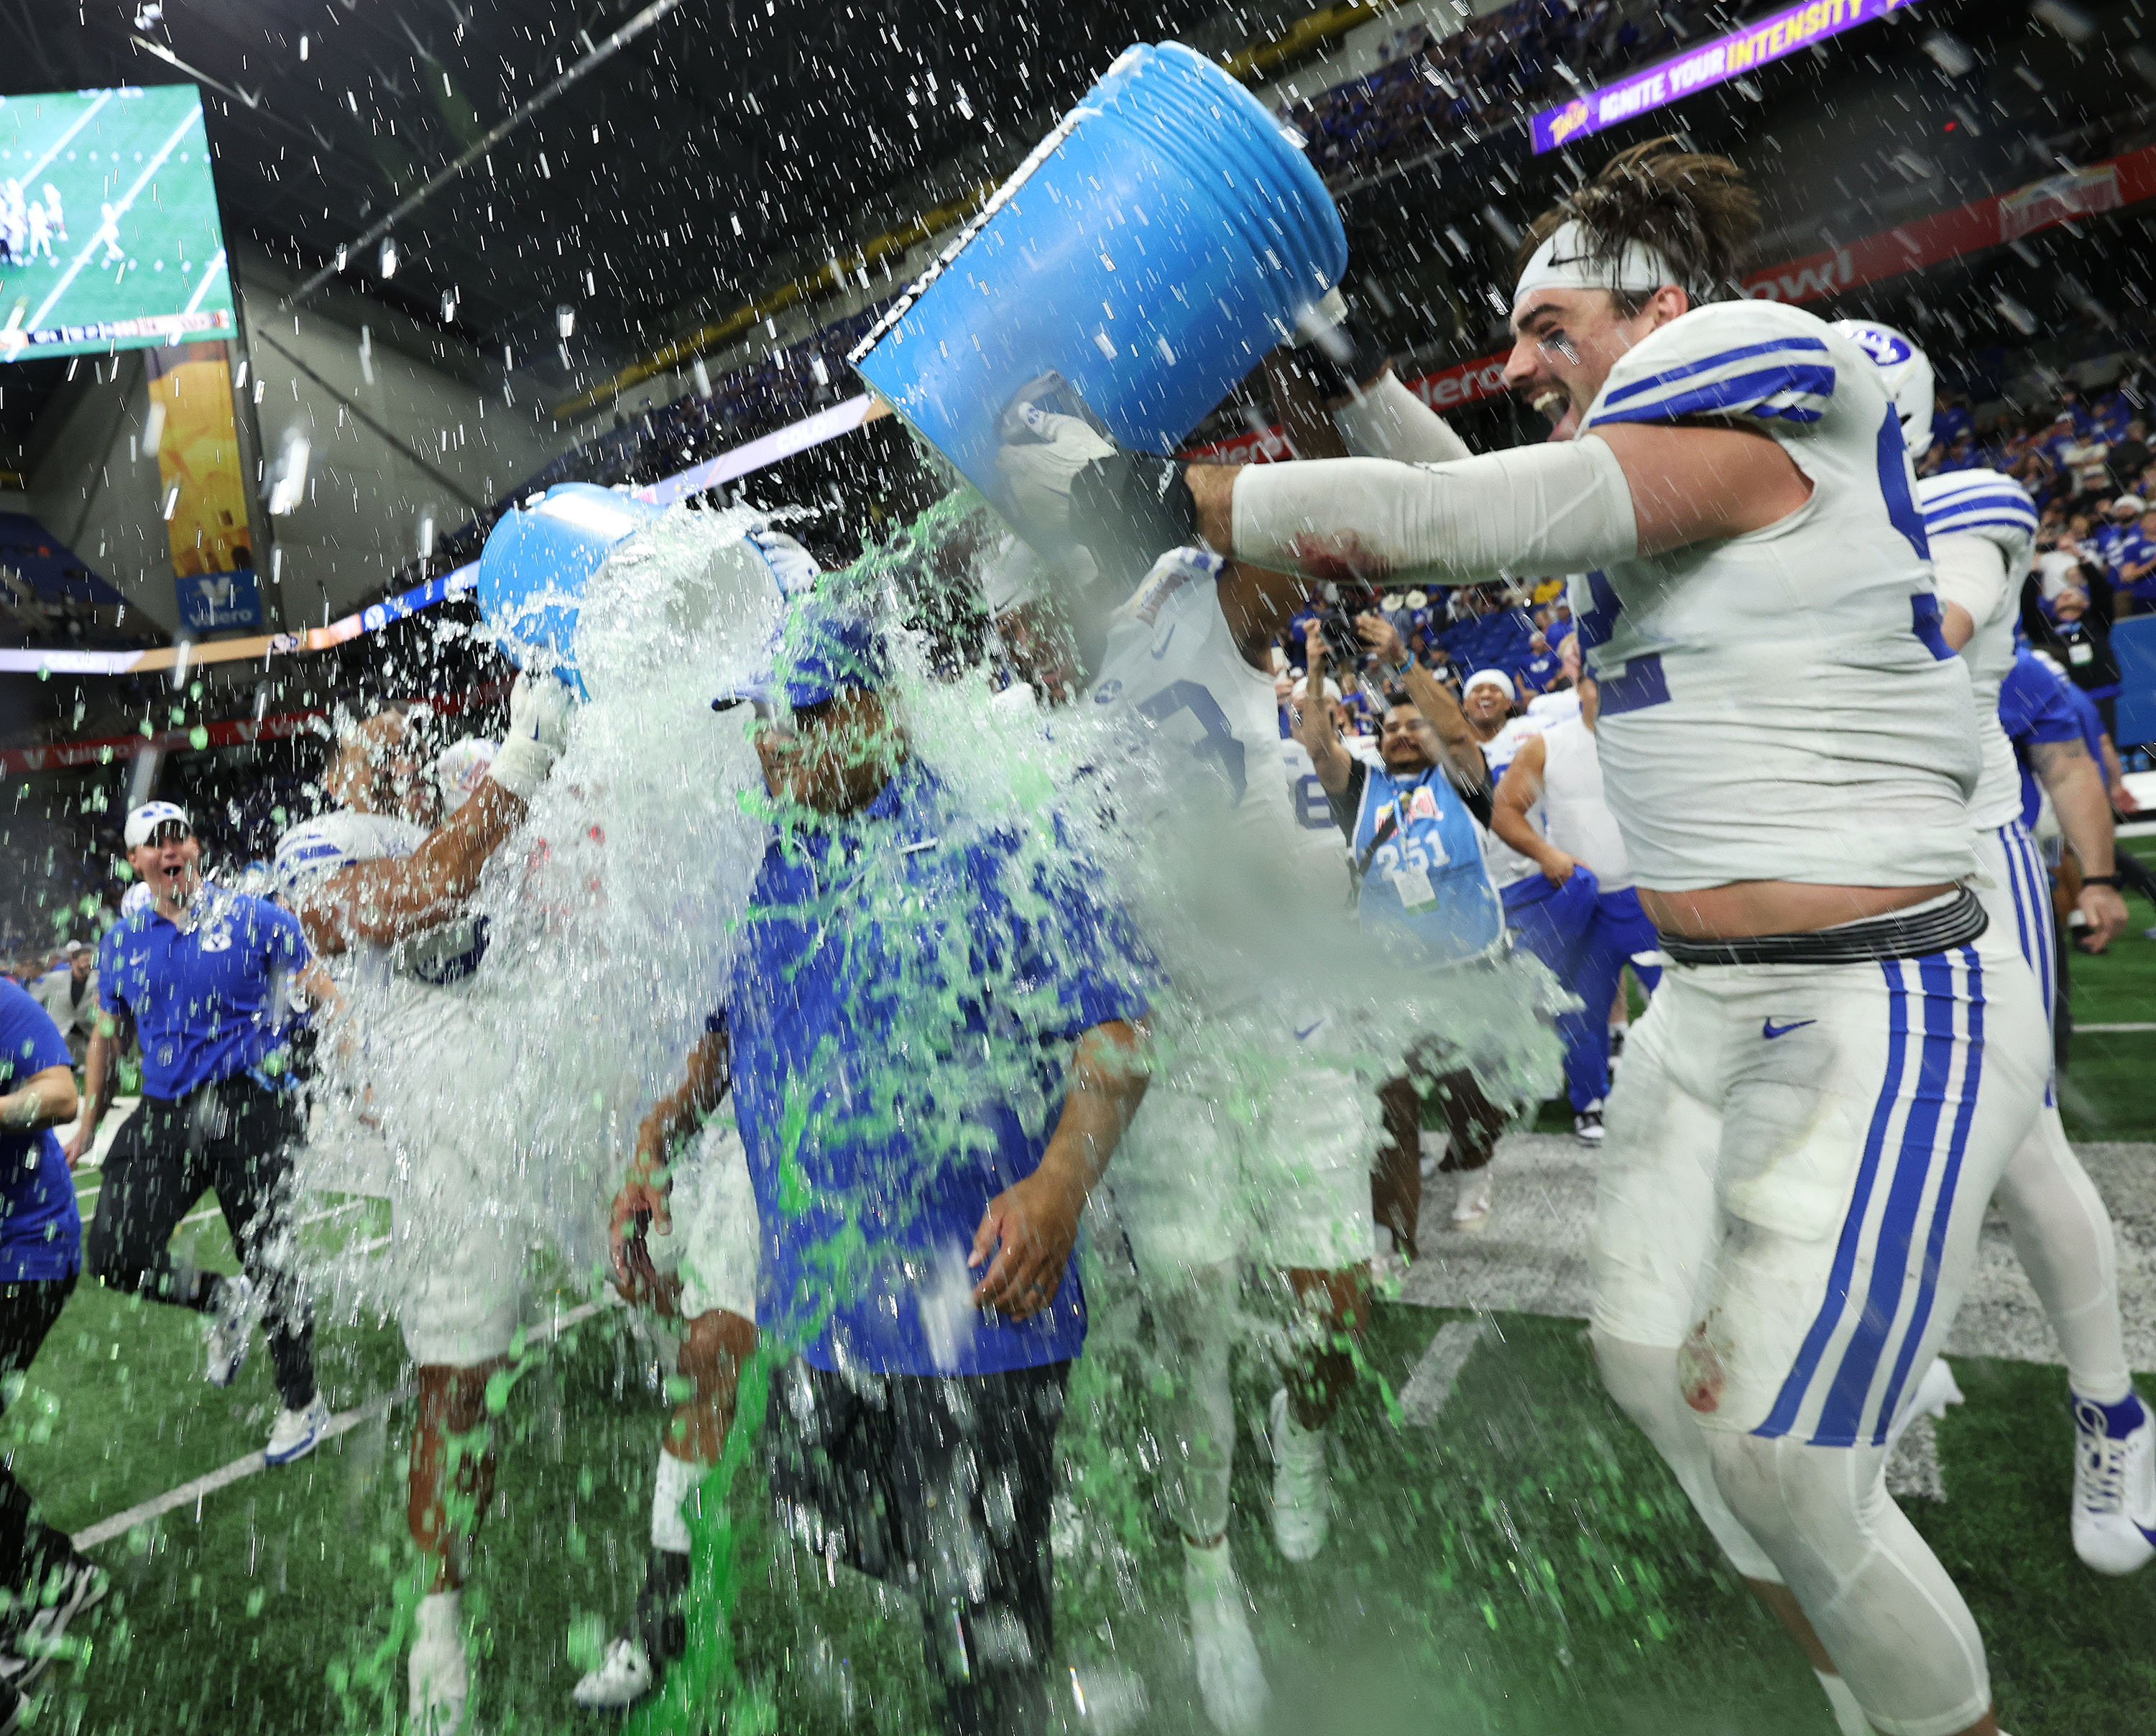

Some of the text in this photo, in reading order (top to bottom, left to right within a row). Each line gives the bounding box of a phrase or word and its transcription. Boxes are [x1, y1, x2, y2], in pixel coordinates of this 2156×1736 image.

[1599, 0, 1862, 123] IGNITE YOUR INTENSITY
[1749, 251, 1853, 300] owl
[1419, 363, 1508, 407] lero
[1377, 829, 1451, 882] 251
